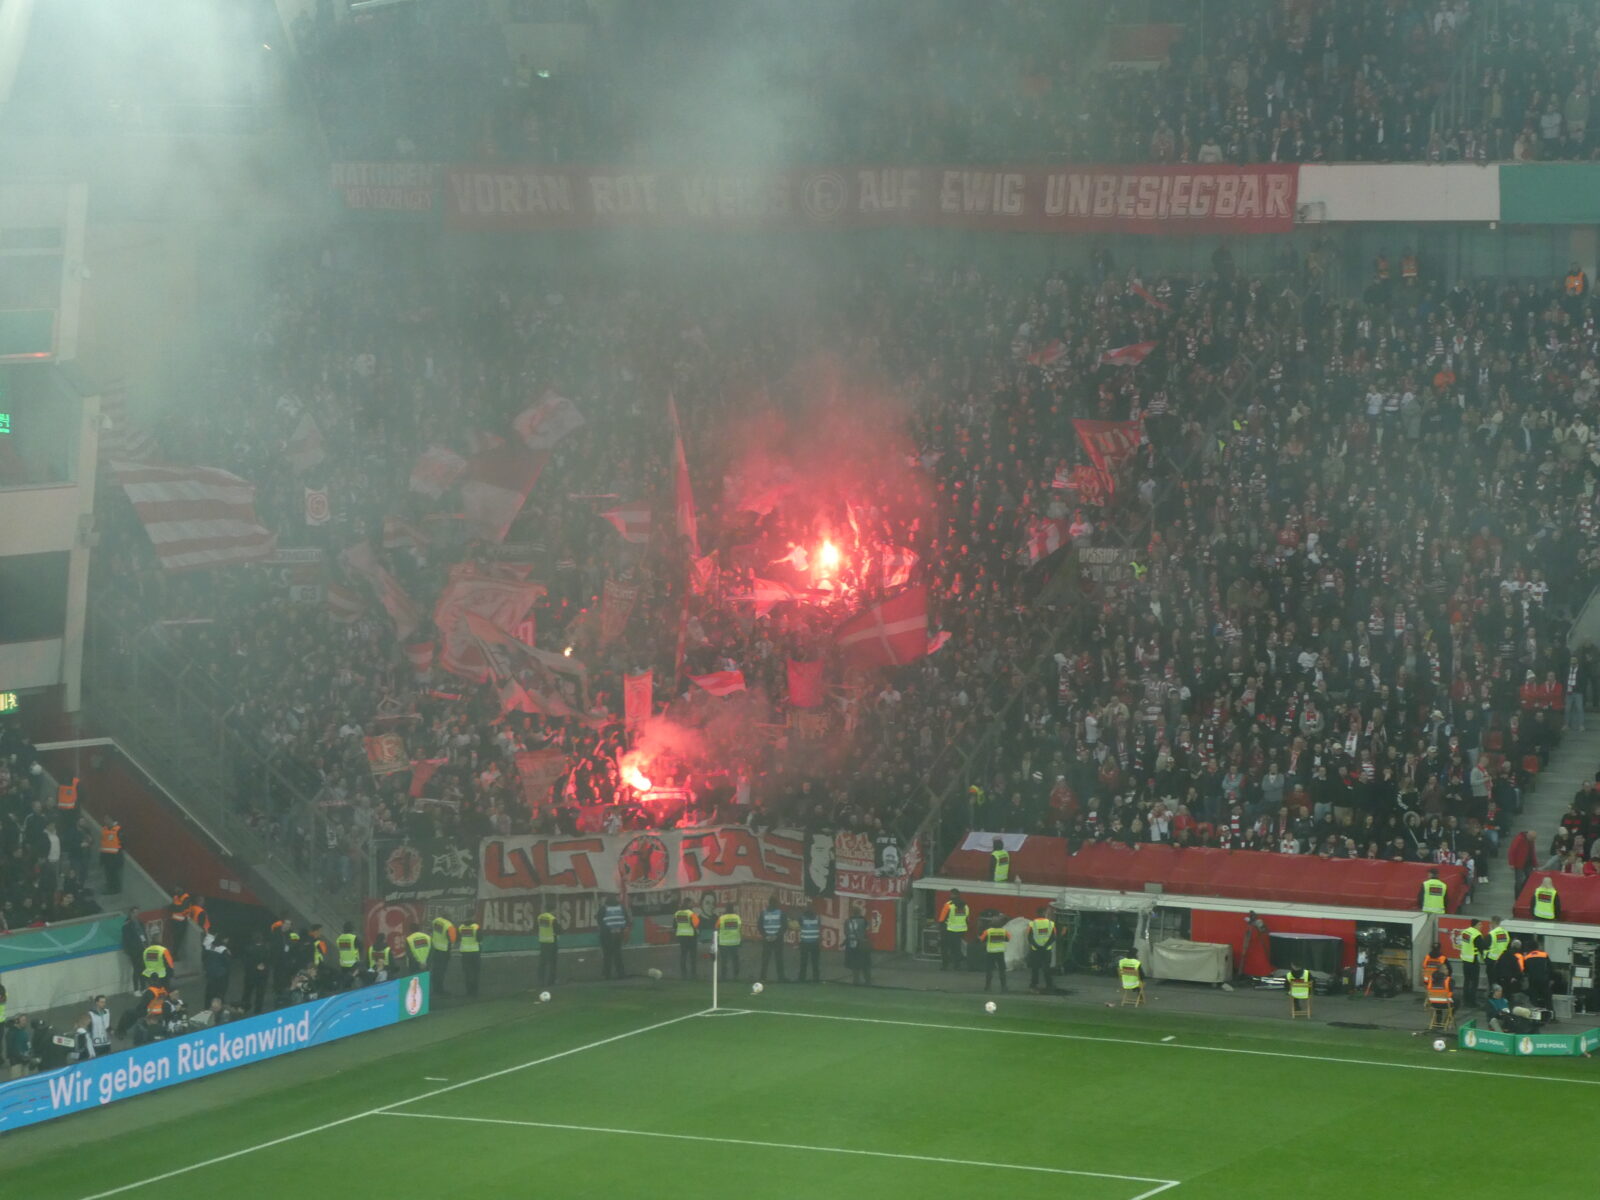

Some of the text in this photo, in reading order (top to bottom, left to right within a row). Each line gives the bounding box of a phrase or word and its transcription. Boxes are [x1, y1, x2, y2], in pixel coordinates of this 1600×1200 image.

[451, 173, 574, 214] VORAN
[588, 174, 658, 214] ROT
[857, 170, 1293, 220] AUF EWIG UNBESIEGBAR
[483, 900, 534, 931] ALLES
[48, 1011, 310, 1110] Wir geben Rückenwind
